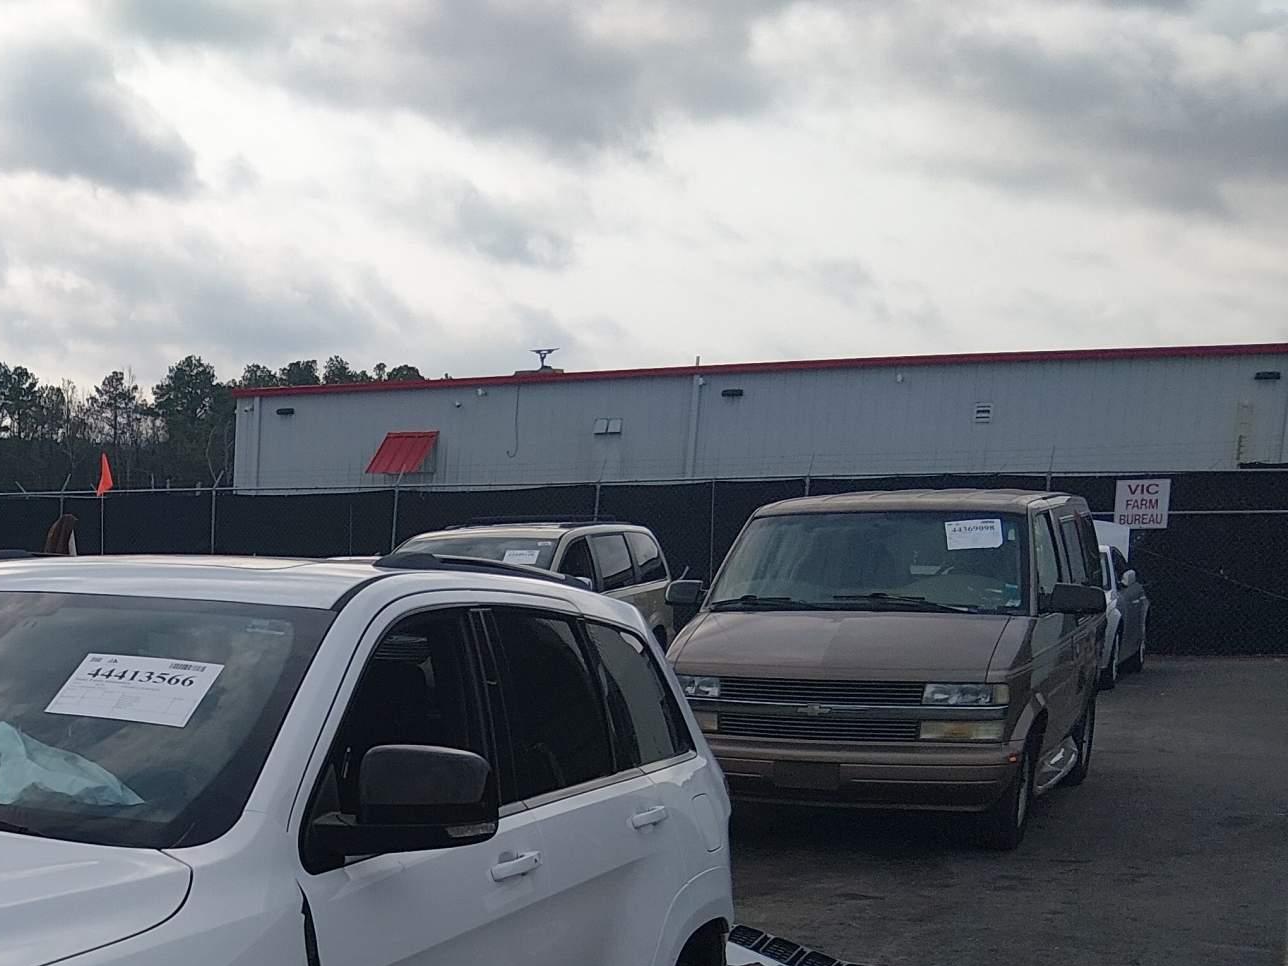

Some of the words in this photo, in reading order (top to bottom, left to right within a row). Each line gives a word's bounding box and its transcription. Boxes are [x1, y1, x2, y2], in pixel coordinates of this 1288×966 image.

[1127, 483, 1160, 495] VIC
[1125, 498, 1159, 510] FARM
[1119, 513, 1163, 525] BUREAU
[87, 667, 197, 687] 44413566
